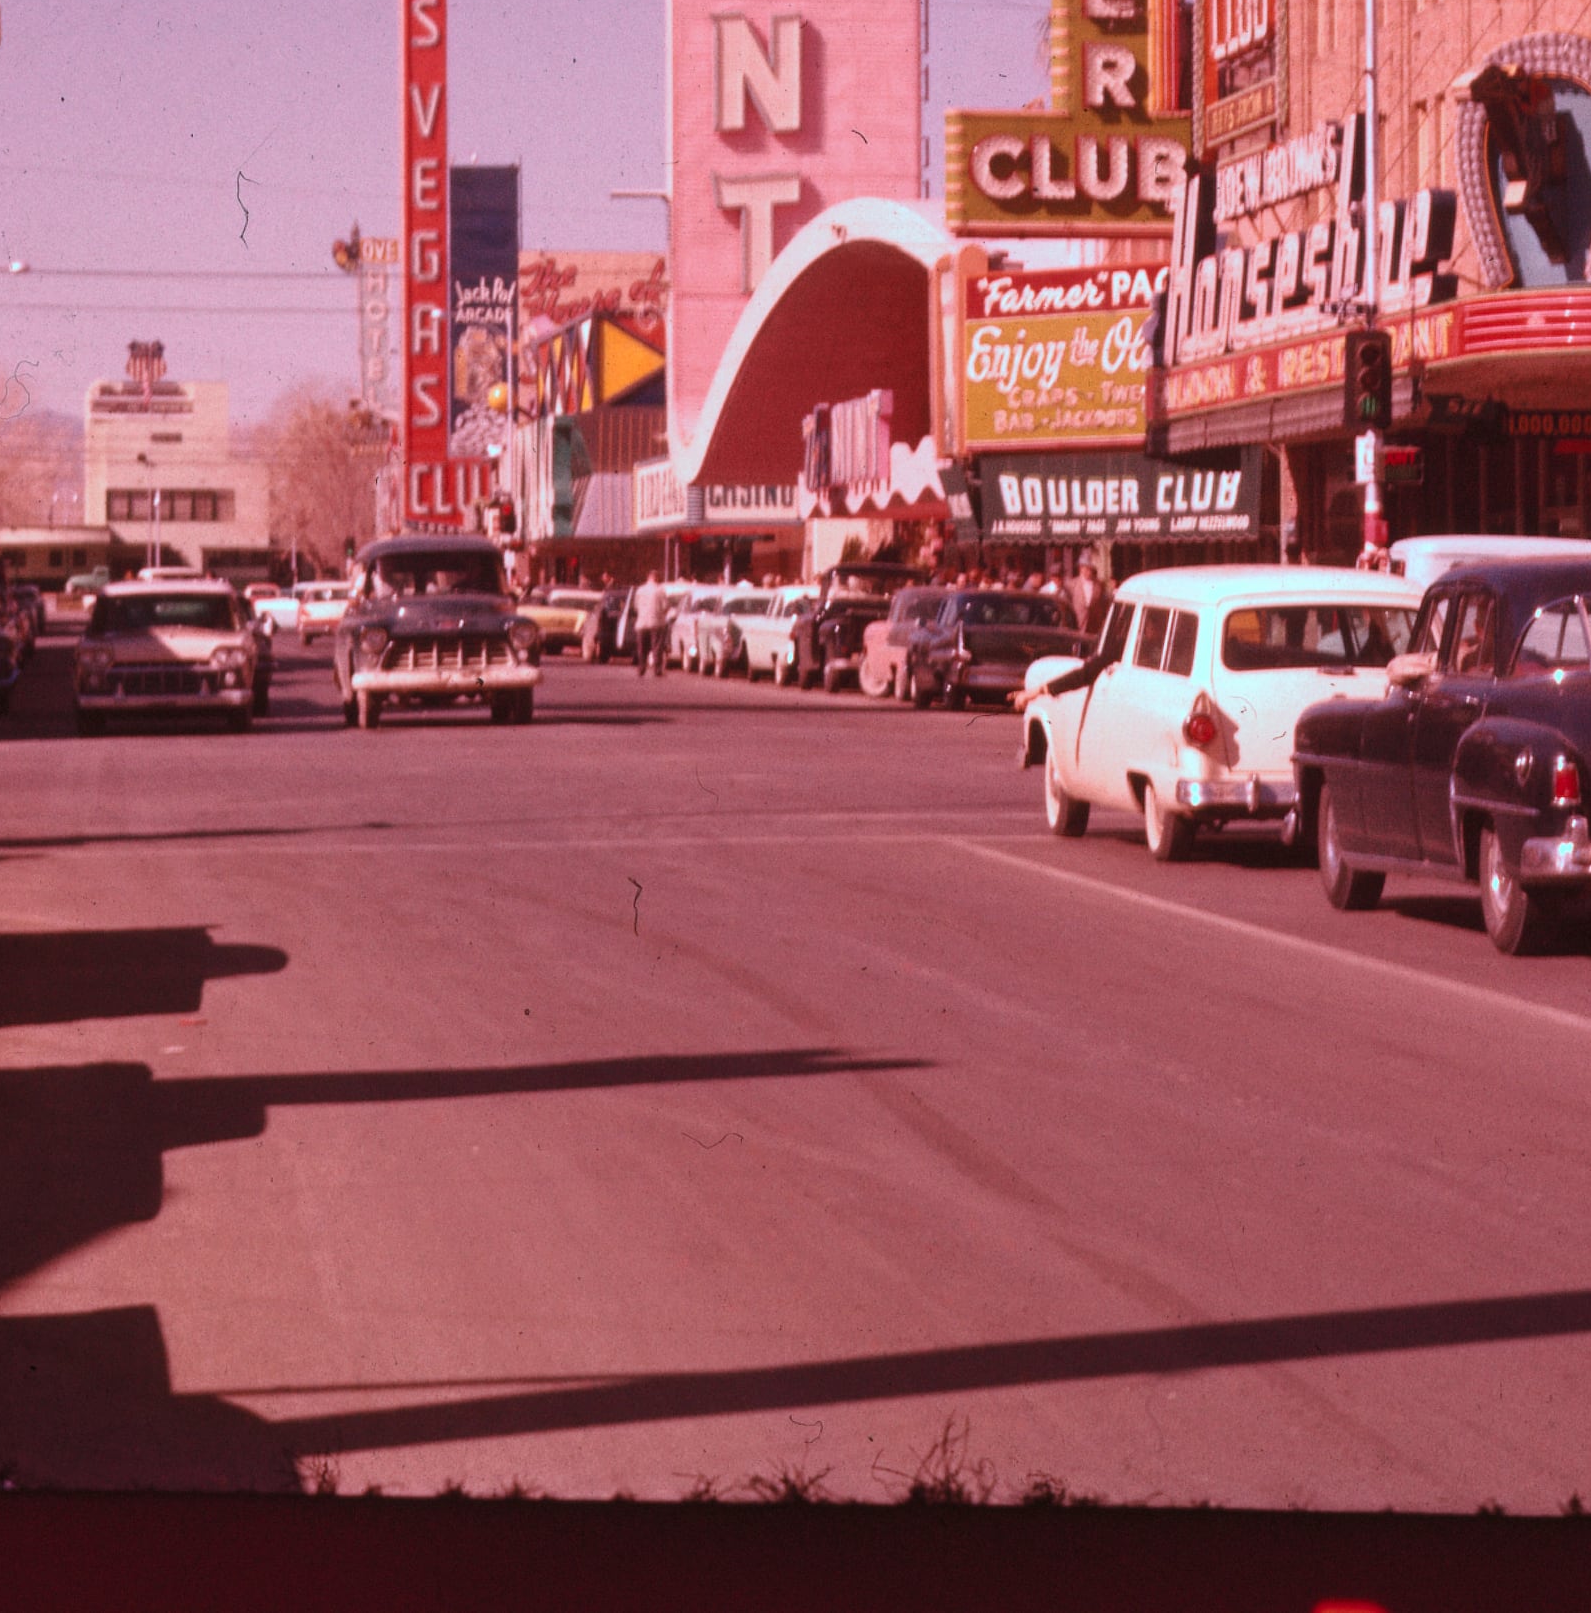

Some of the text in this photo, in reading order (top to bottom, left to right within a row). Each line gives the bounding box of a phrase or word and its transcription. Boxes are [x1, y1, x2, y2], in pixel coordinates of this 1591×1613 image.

[968, 135, 1186, 202] CLUB
[410, 83, 442, 429] VEGAS
[967, 325, 1066, 395] Enjoy
[1166, 362, 1236, 409] LOON
[409, 462, 495, 515] CLU
[998, 470, 1242, 516] BOULDER CLUB
